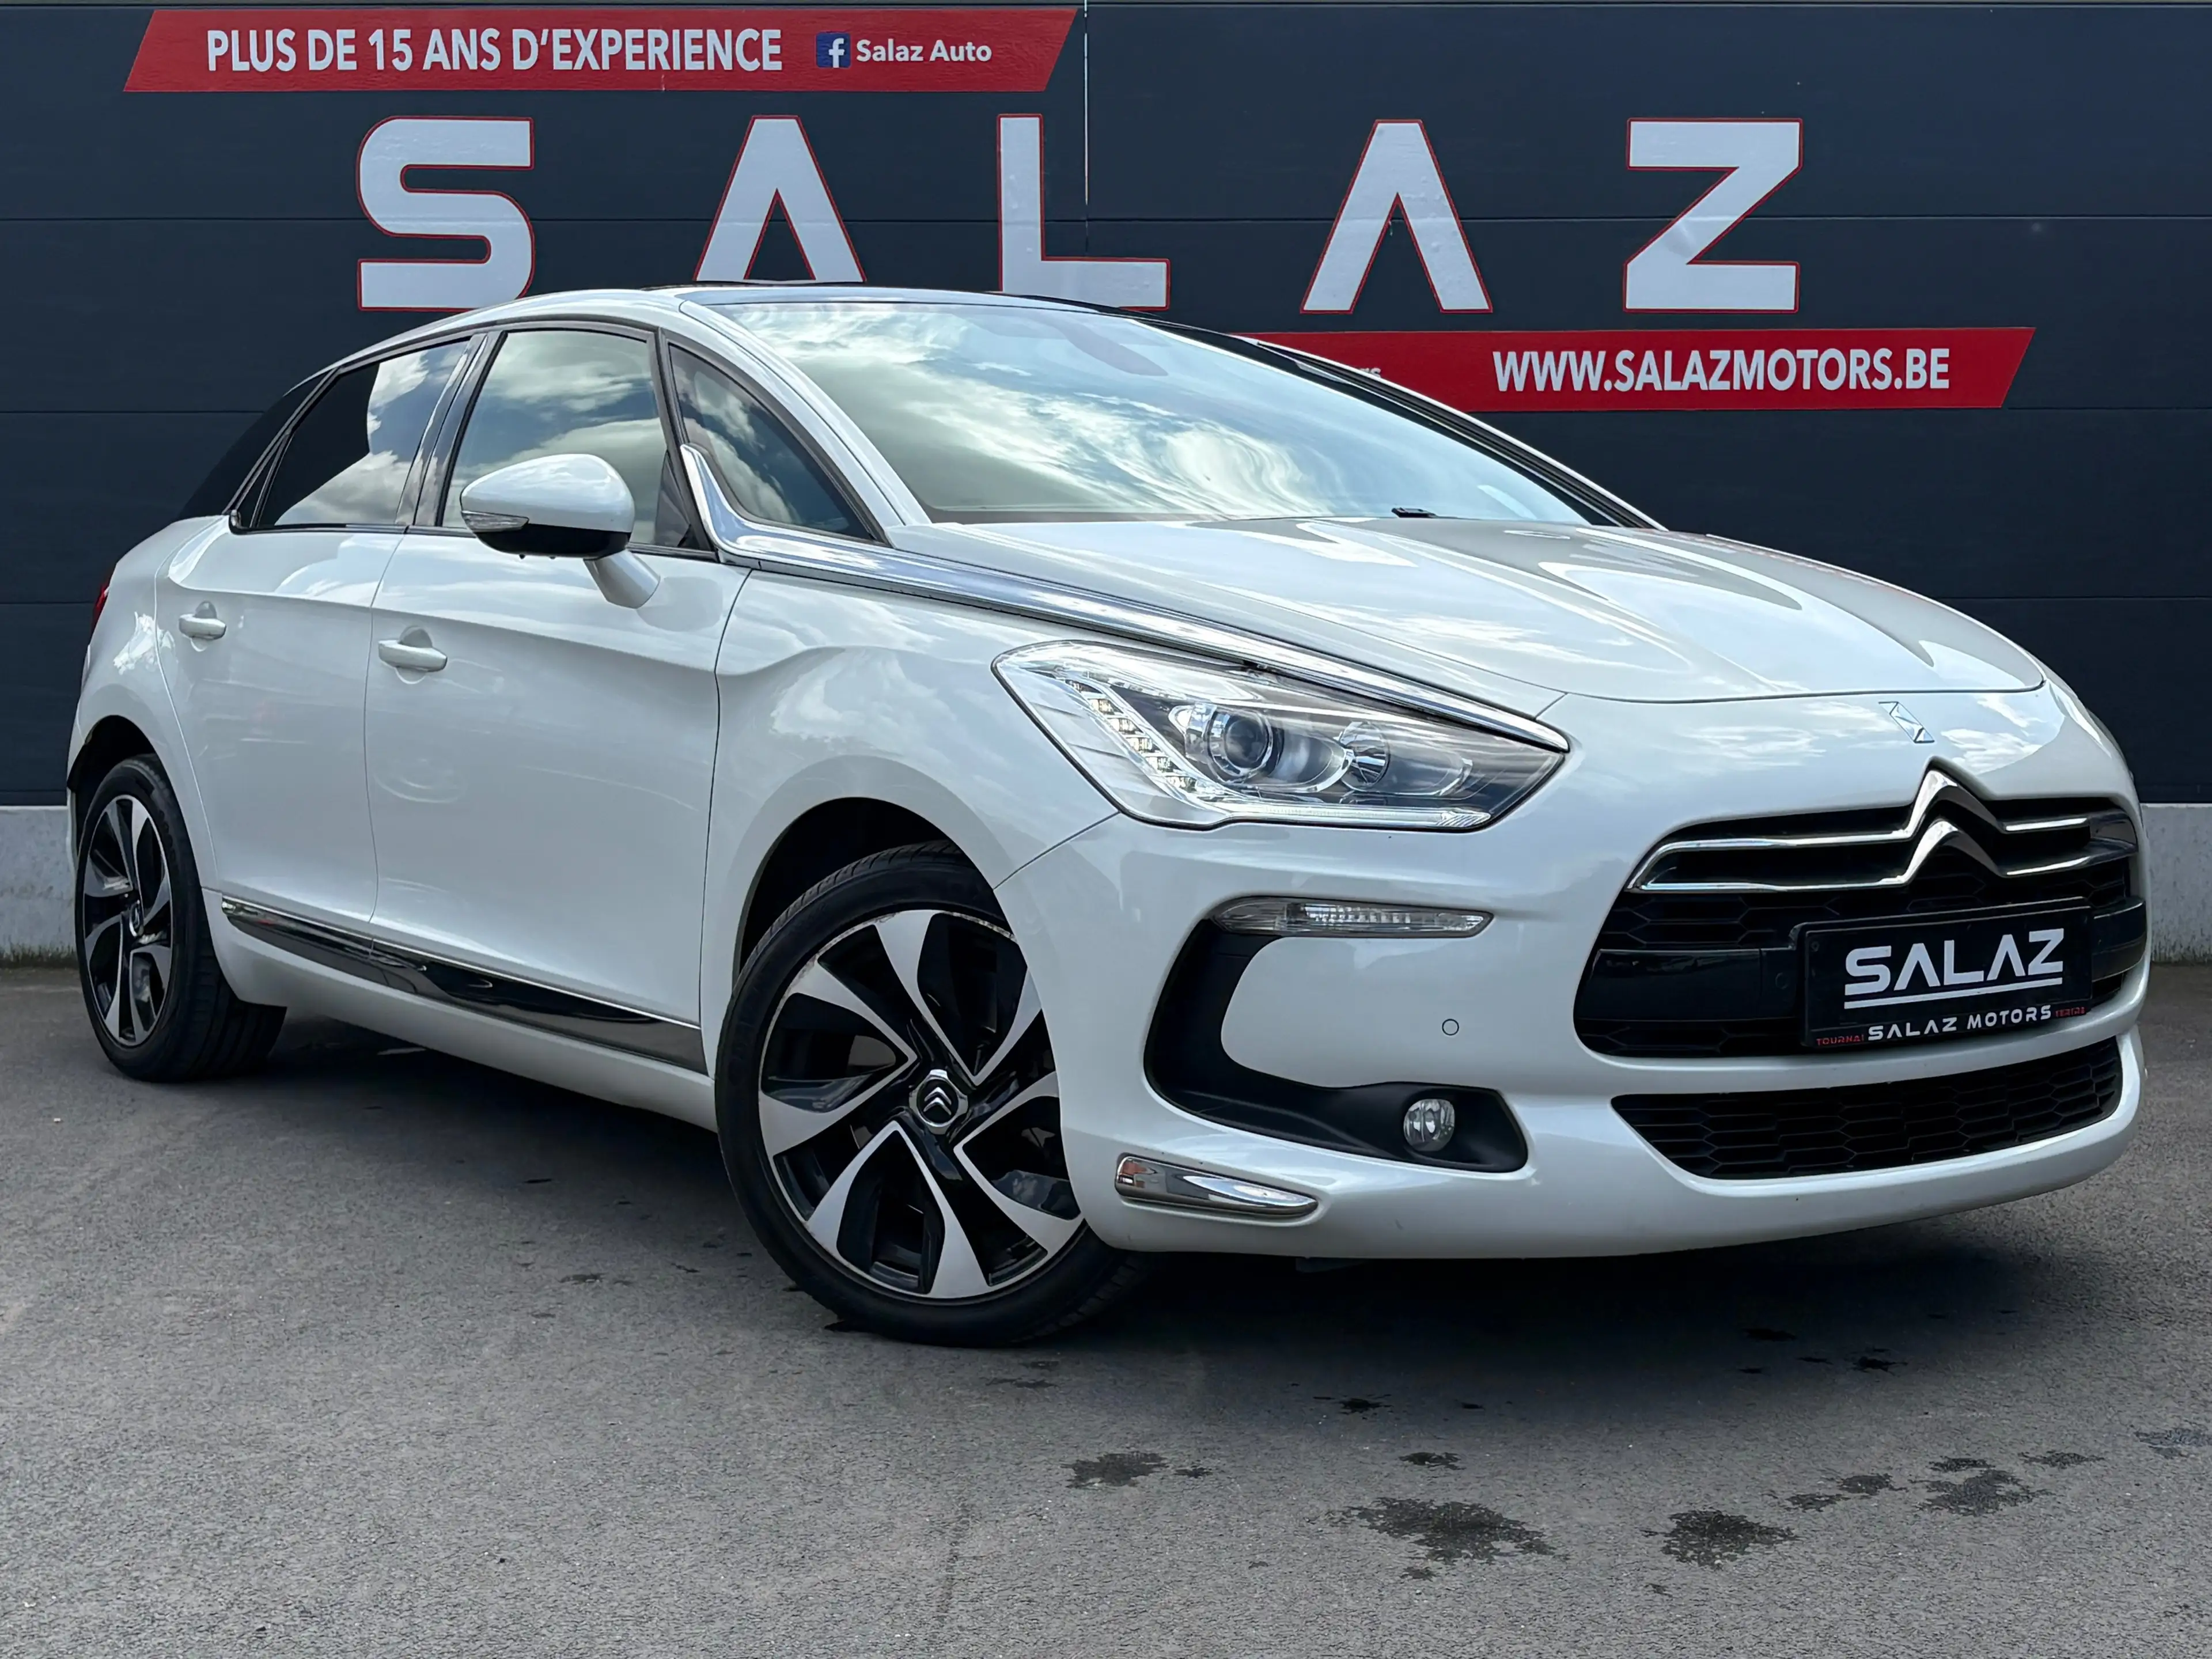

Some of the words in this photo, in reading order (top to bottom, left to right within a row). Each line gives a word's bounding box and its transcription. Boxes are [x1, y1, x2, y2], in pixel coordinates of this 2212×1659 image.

[207, 28, 296, 72] PLUS
[308, 29, 357, 71] DE
[368, 28, 413, 71] 15
[422, 28, 501, 71] ANS
[512, 28, 782, 71] D'EXPERIENCE
[857, 38, 924, 62] Salaz
[929, 39, 992, 62] Auto
[356, 113, 1803, 313] SALAZ
[1493, 348, 1949, 392] WWW.SALAZMOTORS.BE
[1844, 928, 2064, 997] SALAZ
[1868, 1017, 1957, 1041] SALAZ
[1967, 1005, 2051, 1030] MOTORS
